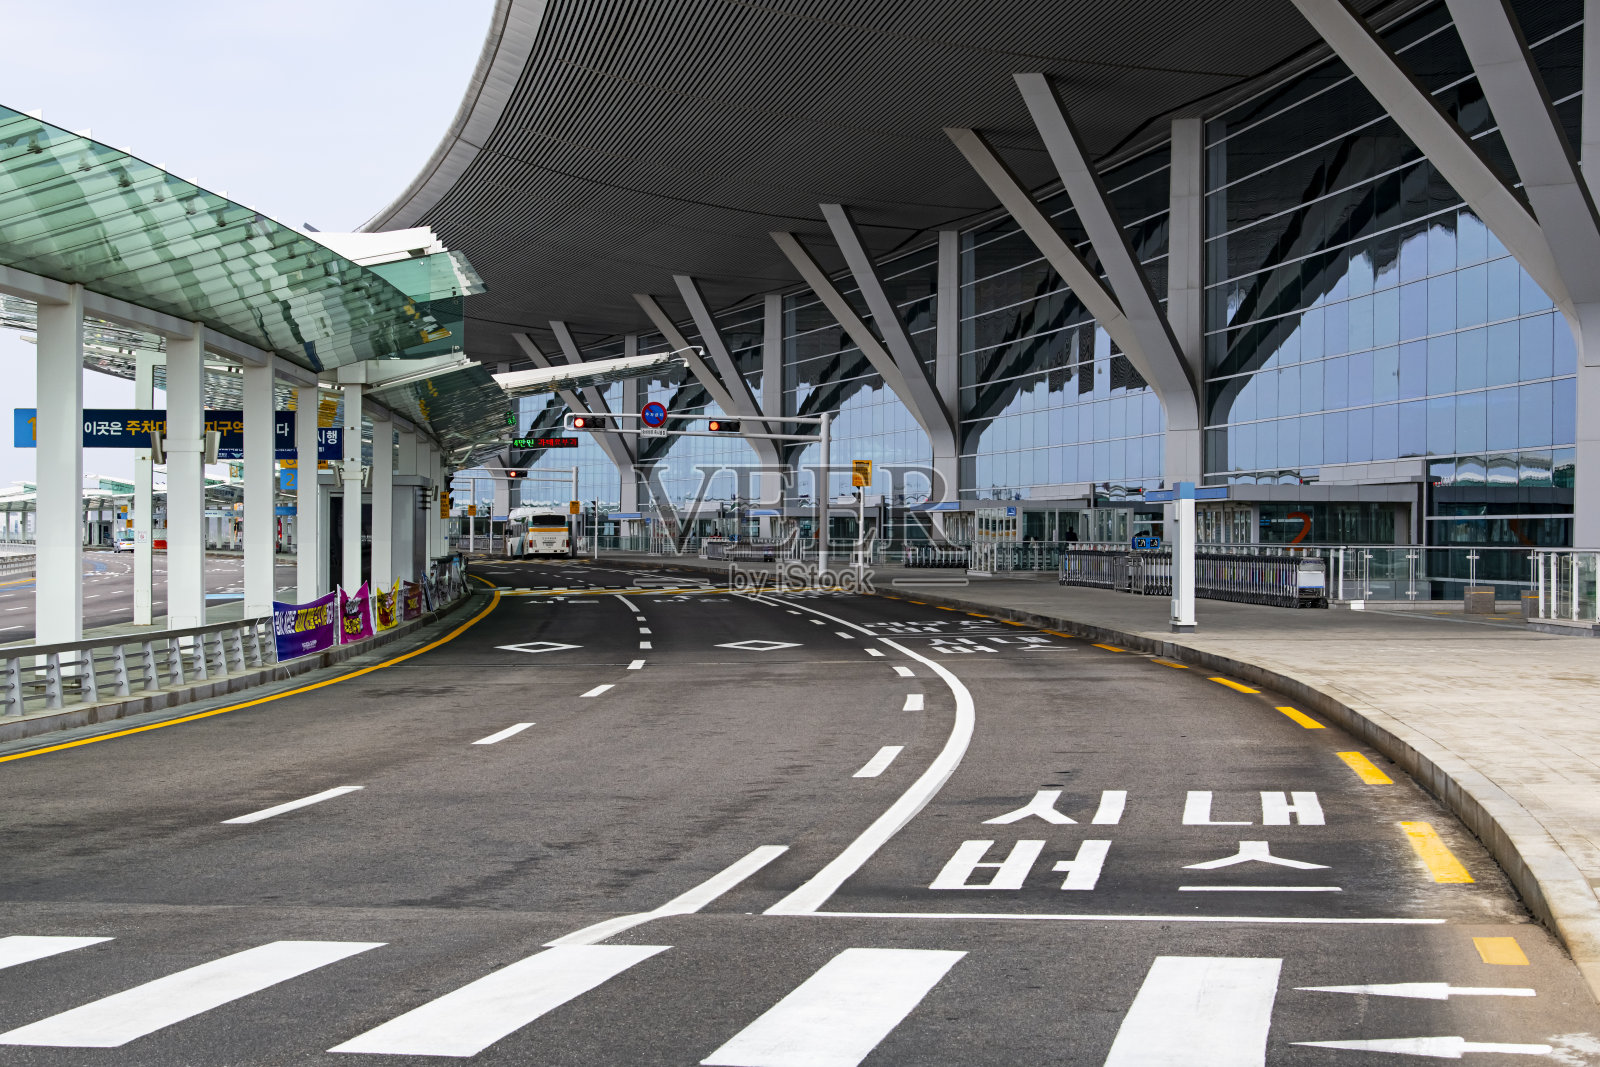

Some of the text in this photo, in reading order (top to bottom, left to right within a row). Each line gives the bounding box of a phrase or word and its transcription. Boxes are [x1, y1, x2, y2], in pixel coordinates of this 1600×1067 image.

[84, 421, 123, 436] 이곳은
[286, 473, 295, 487] 2
[928, 839, 1343, 893] 버스
